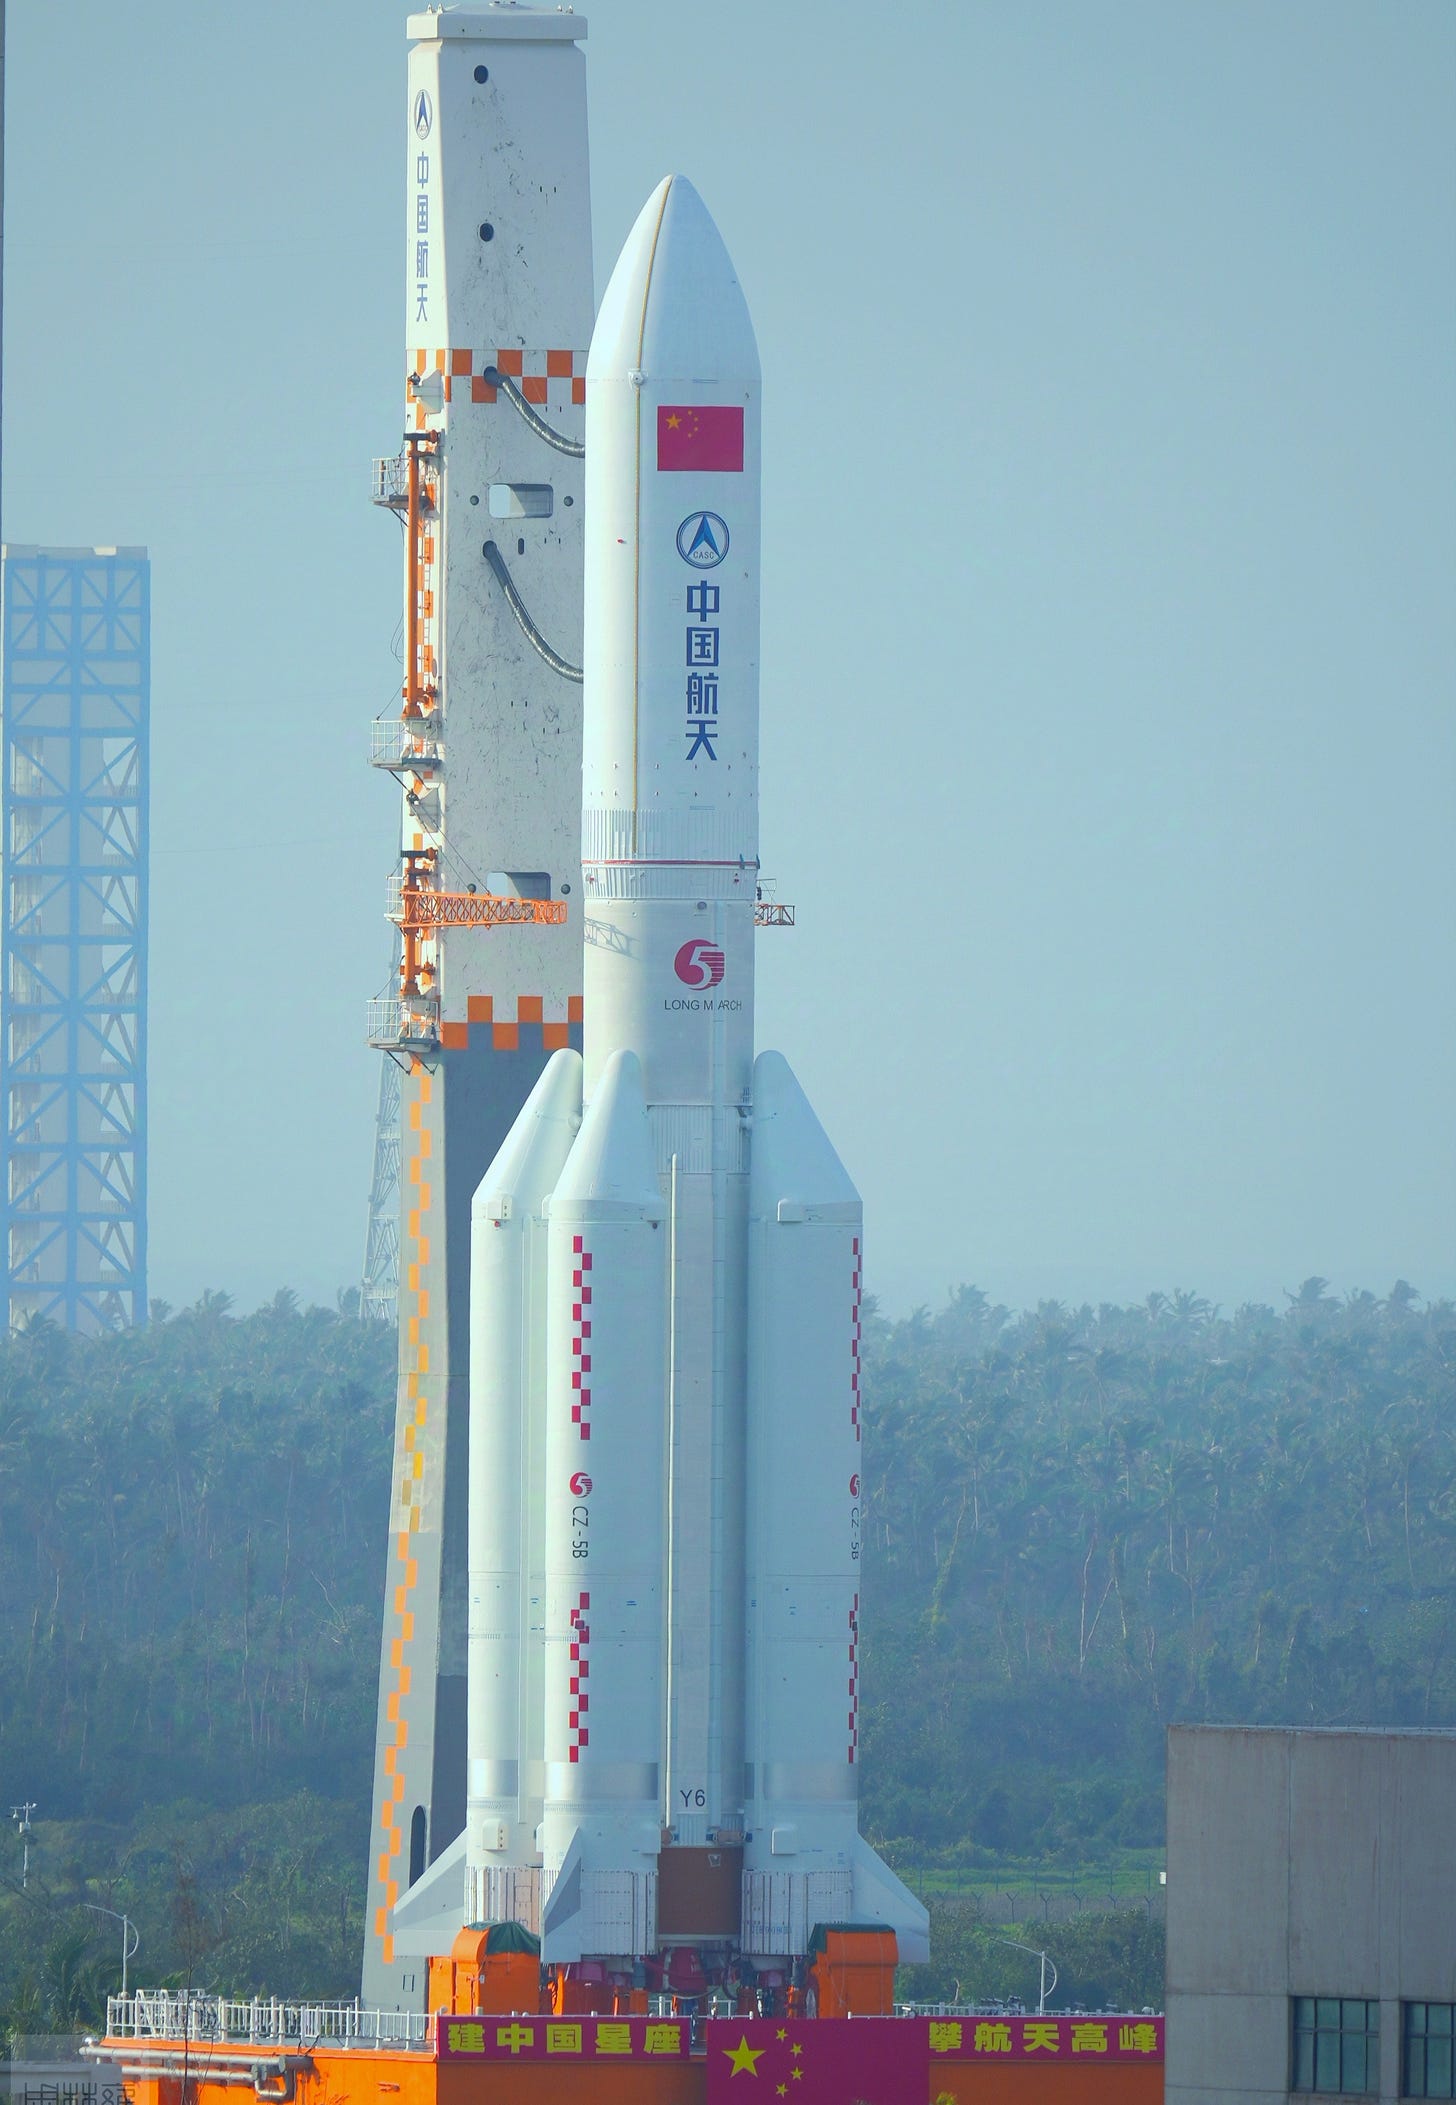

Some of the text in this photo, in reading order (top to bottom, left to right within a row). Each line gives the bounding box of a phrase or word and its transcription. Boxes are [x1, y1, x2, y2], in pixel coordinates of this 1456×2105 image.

[416, 151, 429, 322] 中国航天
[693, 551, 715, 560] CASC
[685, 580, 720, 761] 中国航天
[664, 999, 700, 1011] LONG
[680, 1789, 706, 1808] Y6
[448, 2023, 682, 2054] 建中国星座
[929, 2021, 1158, 2054] 攀航天高峰
